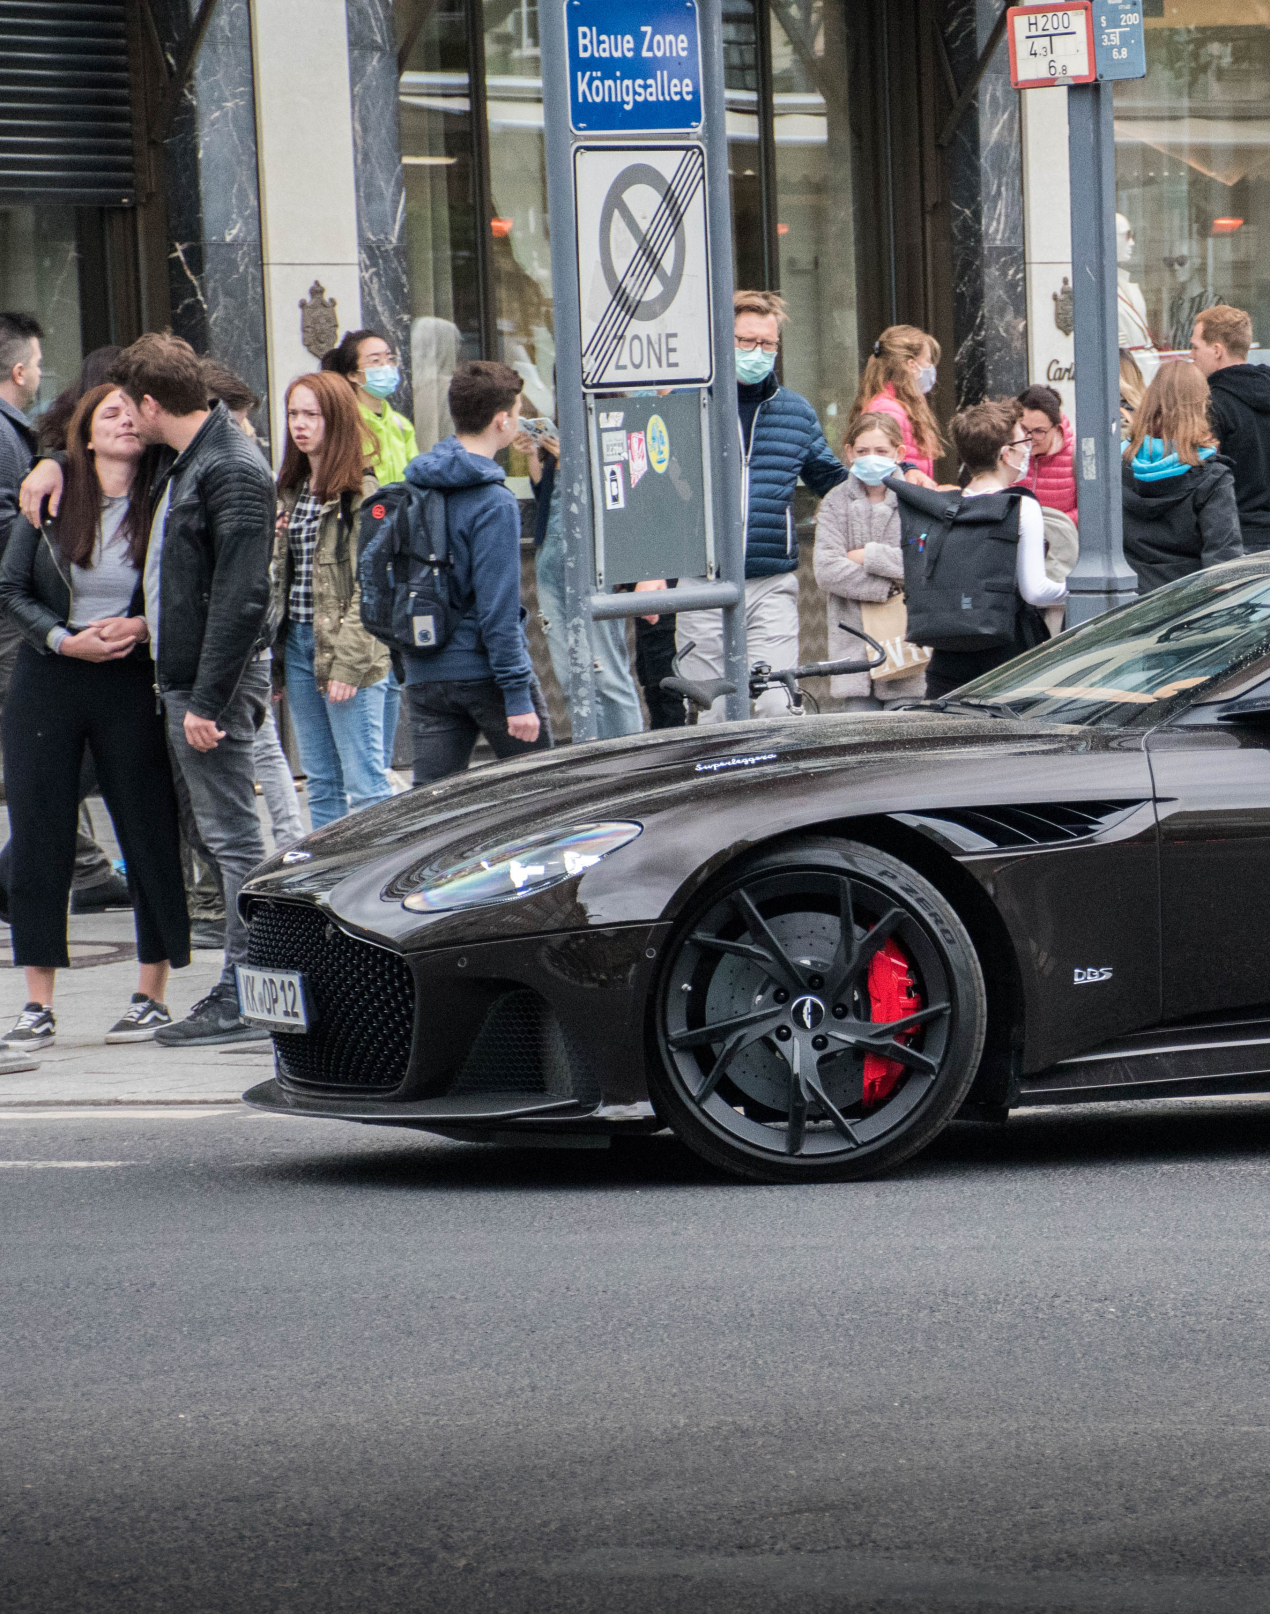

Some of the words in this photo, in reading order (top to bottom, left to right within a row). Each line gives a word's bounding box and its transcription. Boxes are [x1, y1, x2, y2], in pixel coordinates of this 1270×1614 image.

[1100, 15, 1107, 27] S
[1120, 13, 1139, 25] 200
[577, 26, 635, 58] Blaue
[640, 25, 688, 57] Zone
[1048, 59, 1067, 76] 6.8
[577, 70, 693, 111] Königsallee
[613, 332, 679, 371] ZONE
[694, 753, 778, 772] Superleggera
[1073, 966, 1113, 985] DBS
[280, 979, 300, 1019] 12
